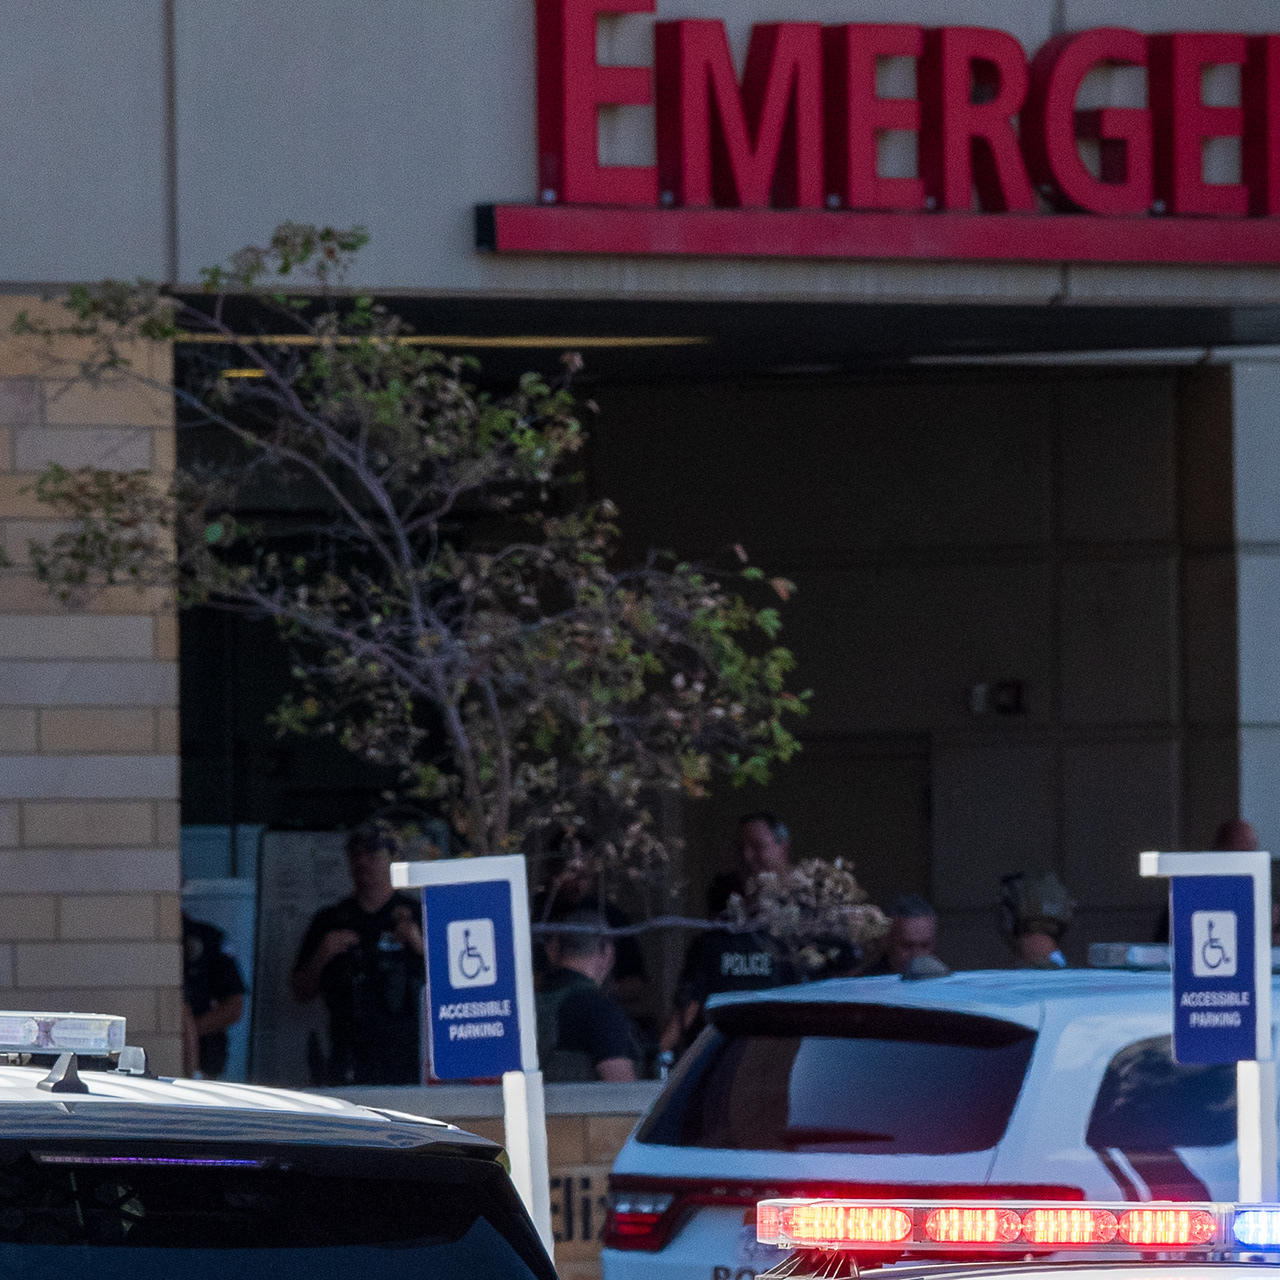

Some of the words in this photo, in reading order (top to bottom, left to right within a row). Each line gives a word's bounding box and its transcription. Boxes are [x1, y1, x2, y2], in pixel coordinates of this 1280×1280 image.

[1181, 991, 1251, 1007] ACCESSIBLE
[439, 999, 511, 1020] ACCESSIBLE
[1189, 1011, 1241, 1028] PARKING
[449, 1021, 504, 1041] PARKING
